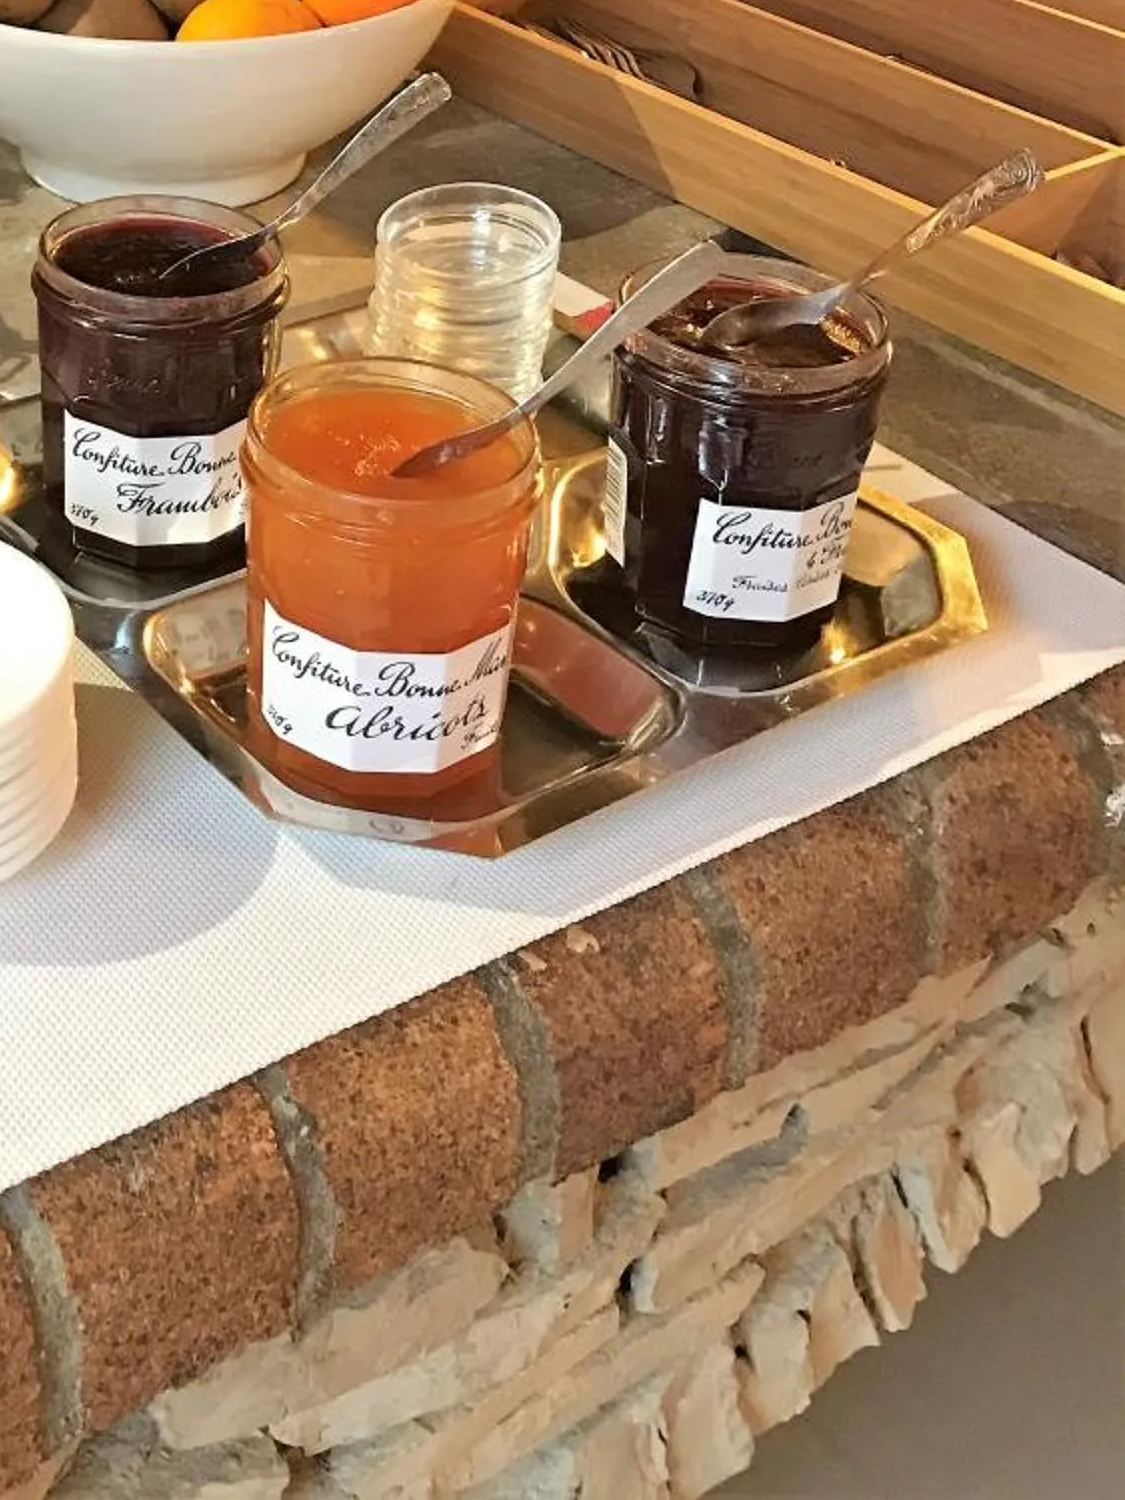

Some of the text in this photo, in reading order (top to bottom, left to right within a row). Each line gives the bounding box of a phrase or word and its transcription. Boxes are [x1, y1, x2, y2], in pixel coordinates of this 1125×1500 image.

[71, 427, 237, 478] Confiture Bonne
[116, 473, 242, 516] Frambois
[713, 512, 814, 555] Confiture
[816, 501, 852, 542] Bon
[270, 624, 371, 698] Confiture
[372, 660, 463, 699] Bonne
[323, 693, 490, 742] Abricots
